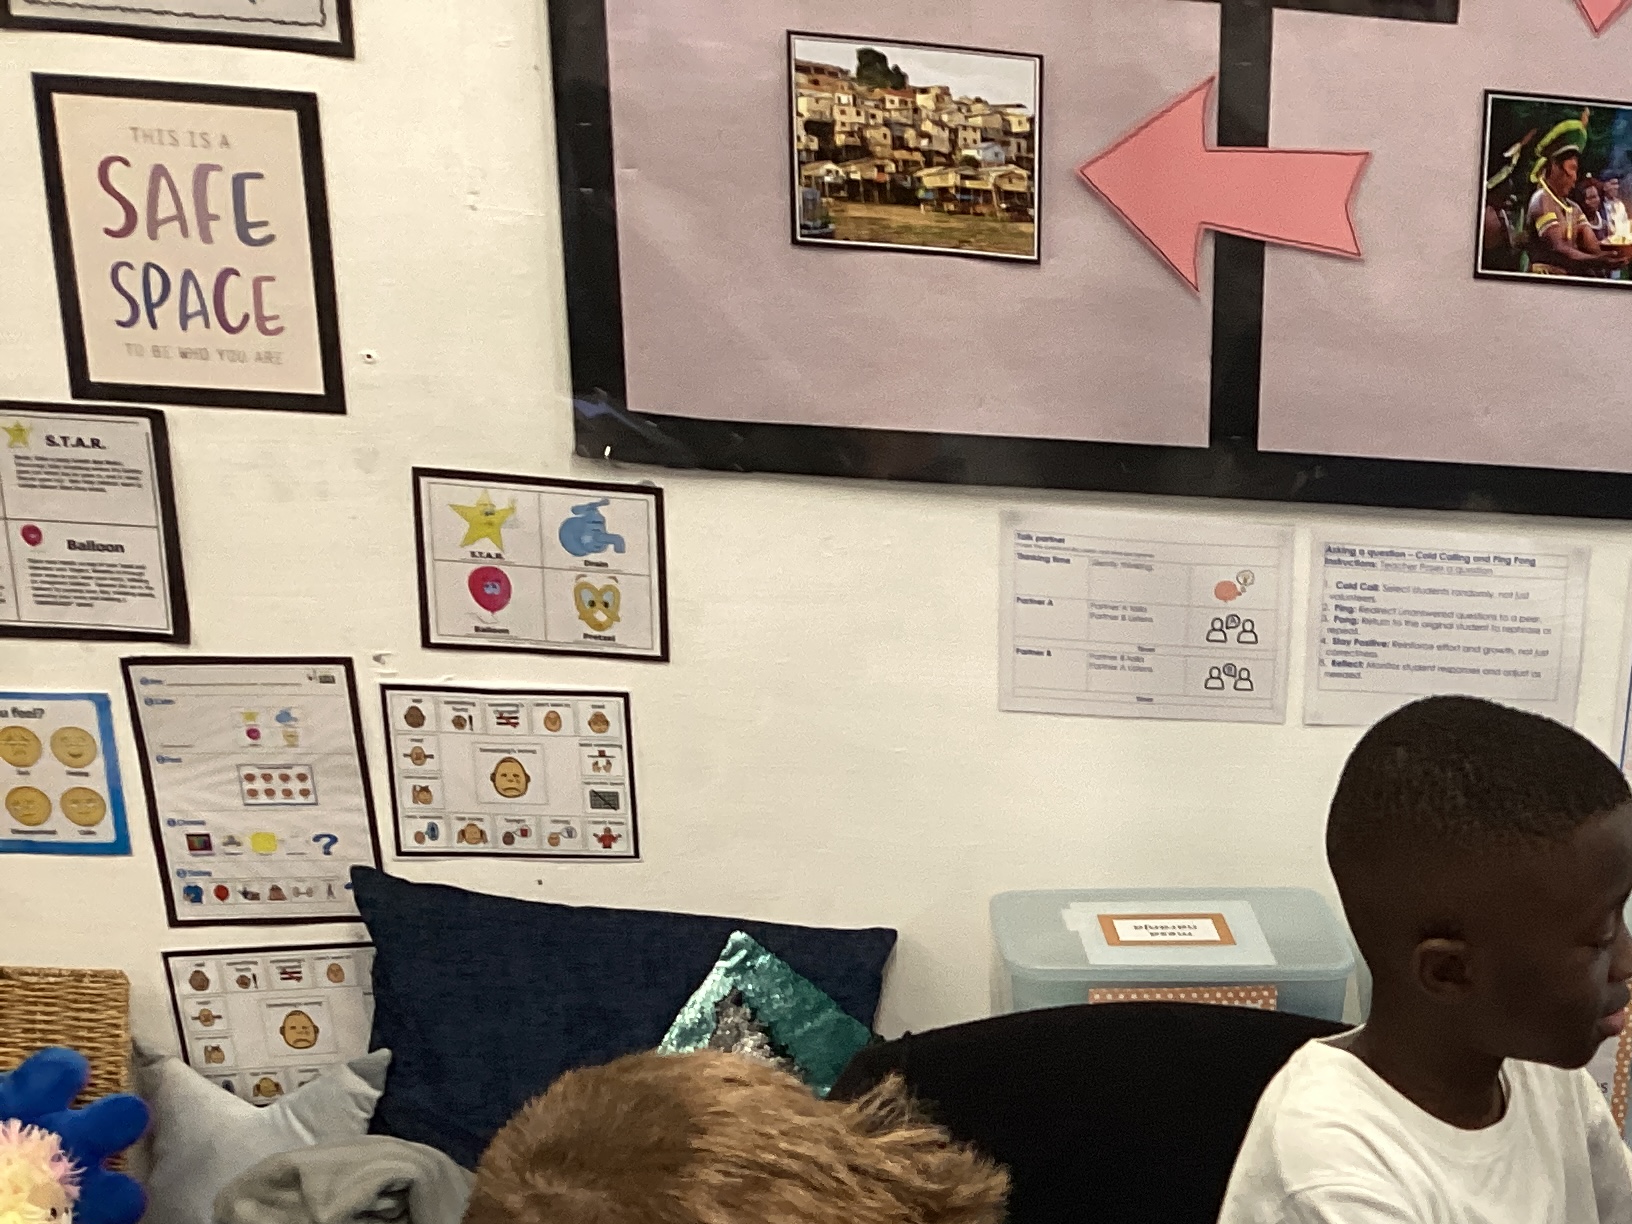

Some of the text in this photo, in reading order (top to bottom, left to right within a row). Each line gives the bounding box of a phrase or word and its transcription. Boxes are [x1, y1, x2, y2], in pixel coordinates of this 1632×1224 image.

[129, 126, 231, 149] THIS IS A
[97, 155, 276, 247] SAFE
[110, 260, 285, 337] SPACE
[124, 342, 284, 365] TO BE WHO YOU ARE
[45, 434, 106, 449] S.T.A.R.
[66, 539, 126, 553] Balloon
[1325, 545, 1356, 557] Asking
[1367, 550, 1406, 559] question
[1415, 550, 1437, 560] Cold
[1439, 552, 1470, 565] Calling
[1472, 555, 1491, 563] and
[1493, 555, 1512, 567] Ping
[1514, 556, 1536, 568] Pong
[1335, 580, 1358, 591] Cold
[1089, 602, 1119, 611] Partner
[1089, 611, 1119, 621] Partner
